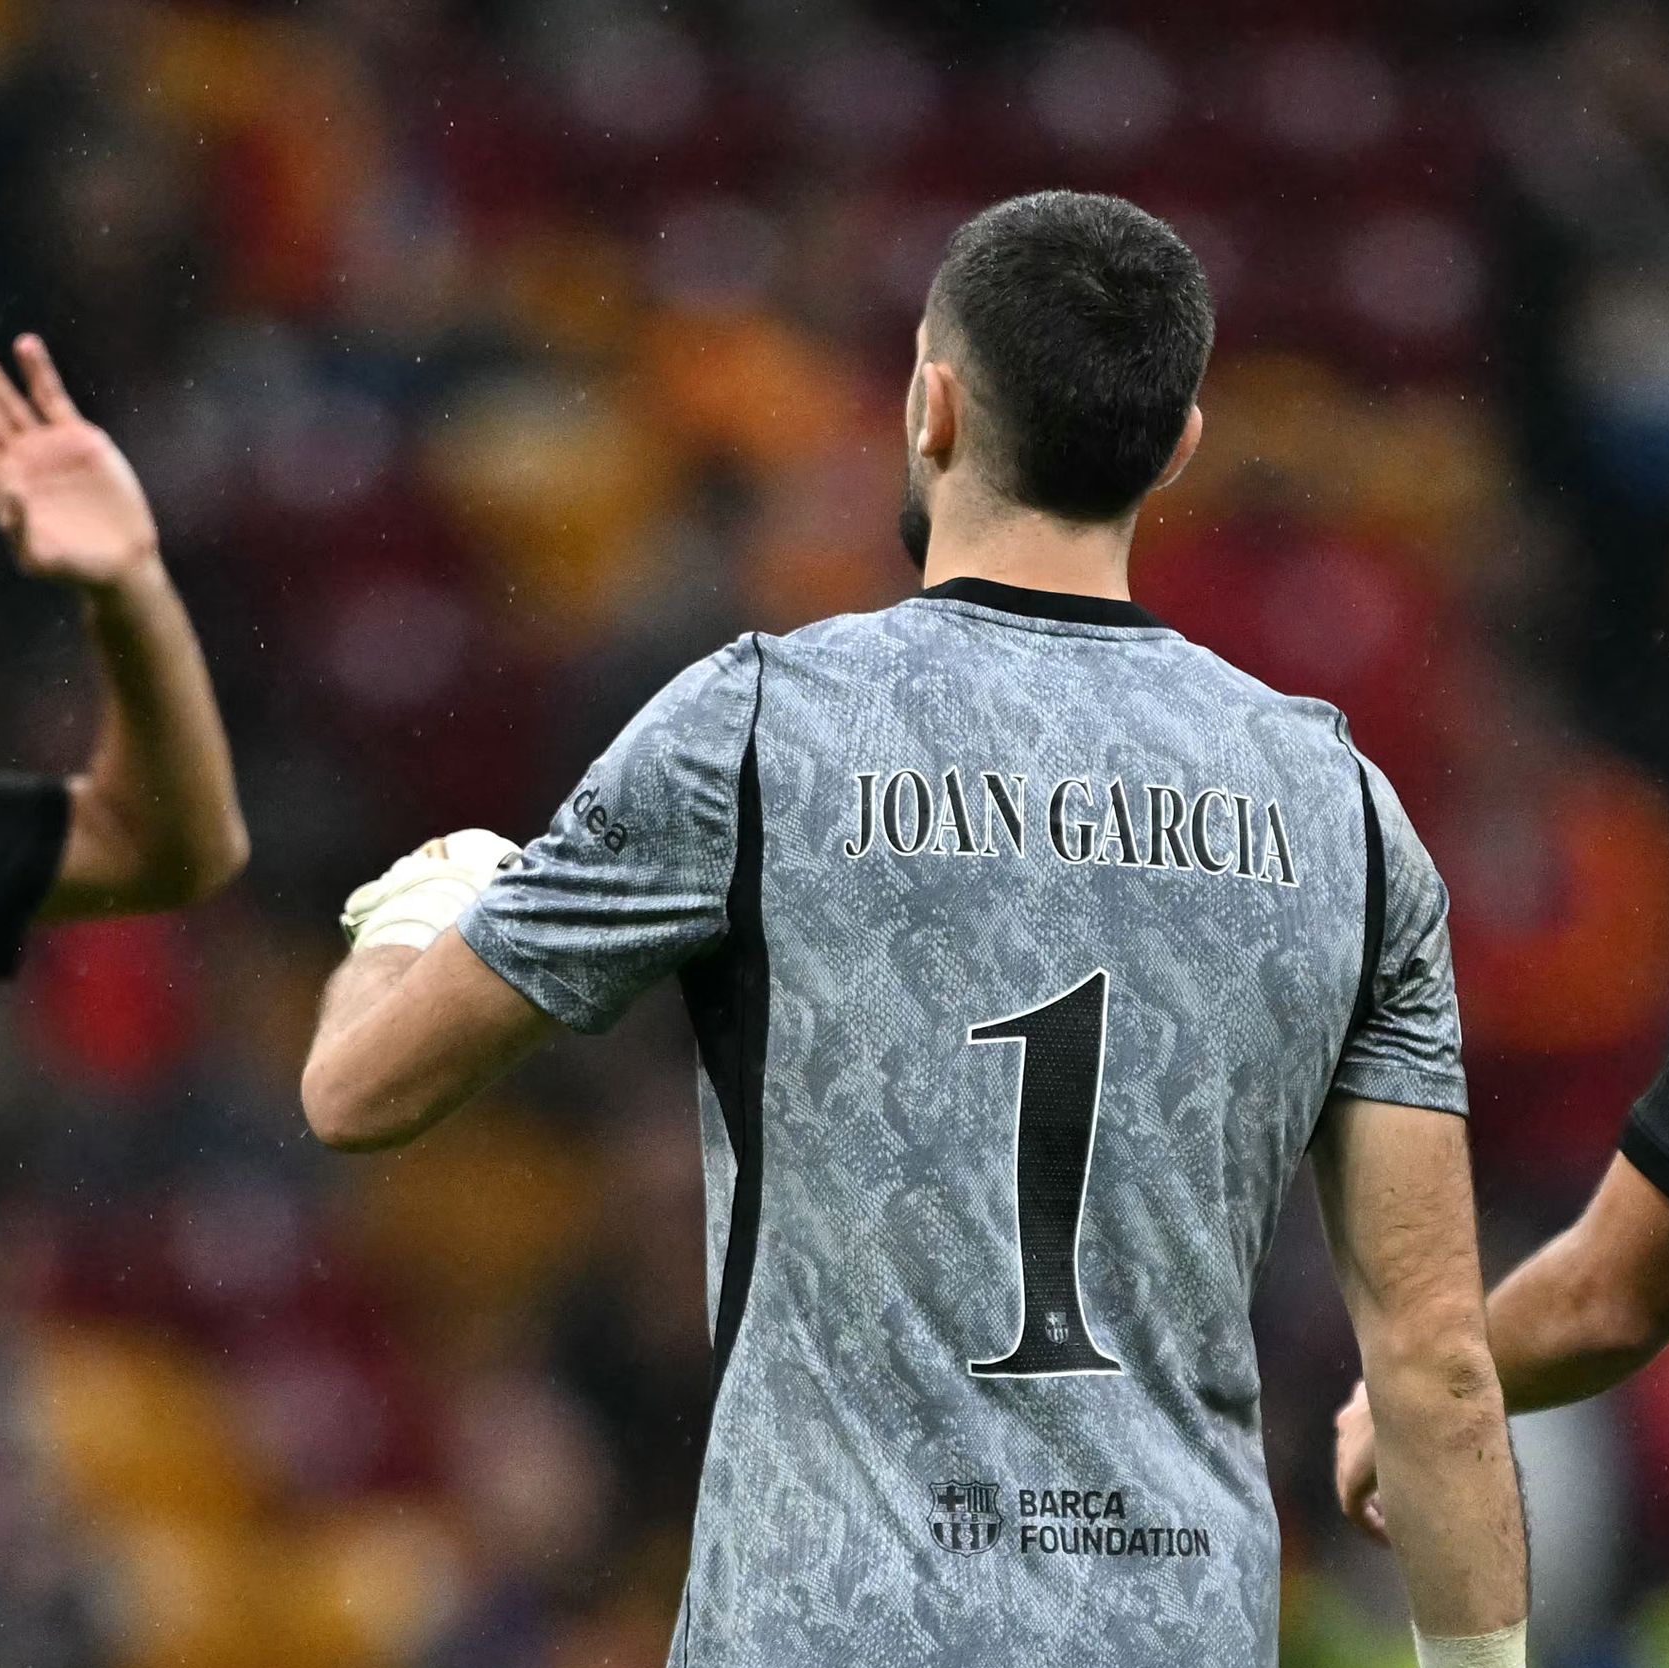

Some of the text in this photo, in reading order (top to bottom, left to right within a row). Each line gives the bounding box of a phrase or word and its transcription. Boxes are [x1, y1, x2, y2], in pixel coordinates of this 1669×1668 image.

[844, 767, 1302, 889] JOAN GARCIA
[966, 966, 1124, 1379] 1
[1018, 1489, 1126, 1525] BARÇA
[1020, 1525, 1211, 1557] FOUNDATION
